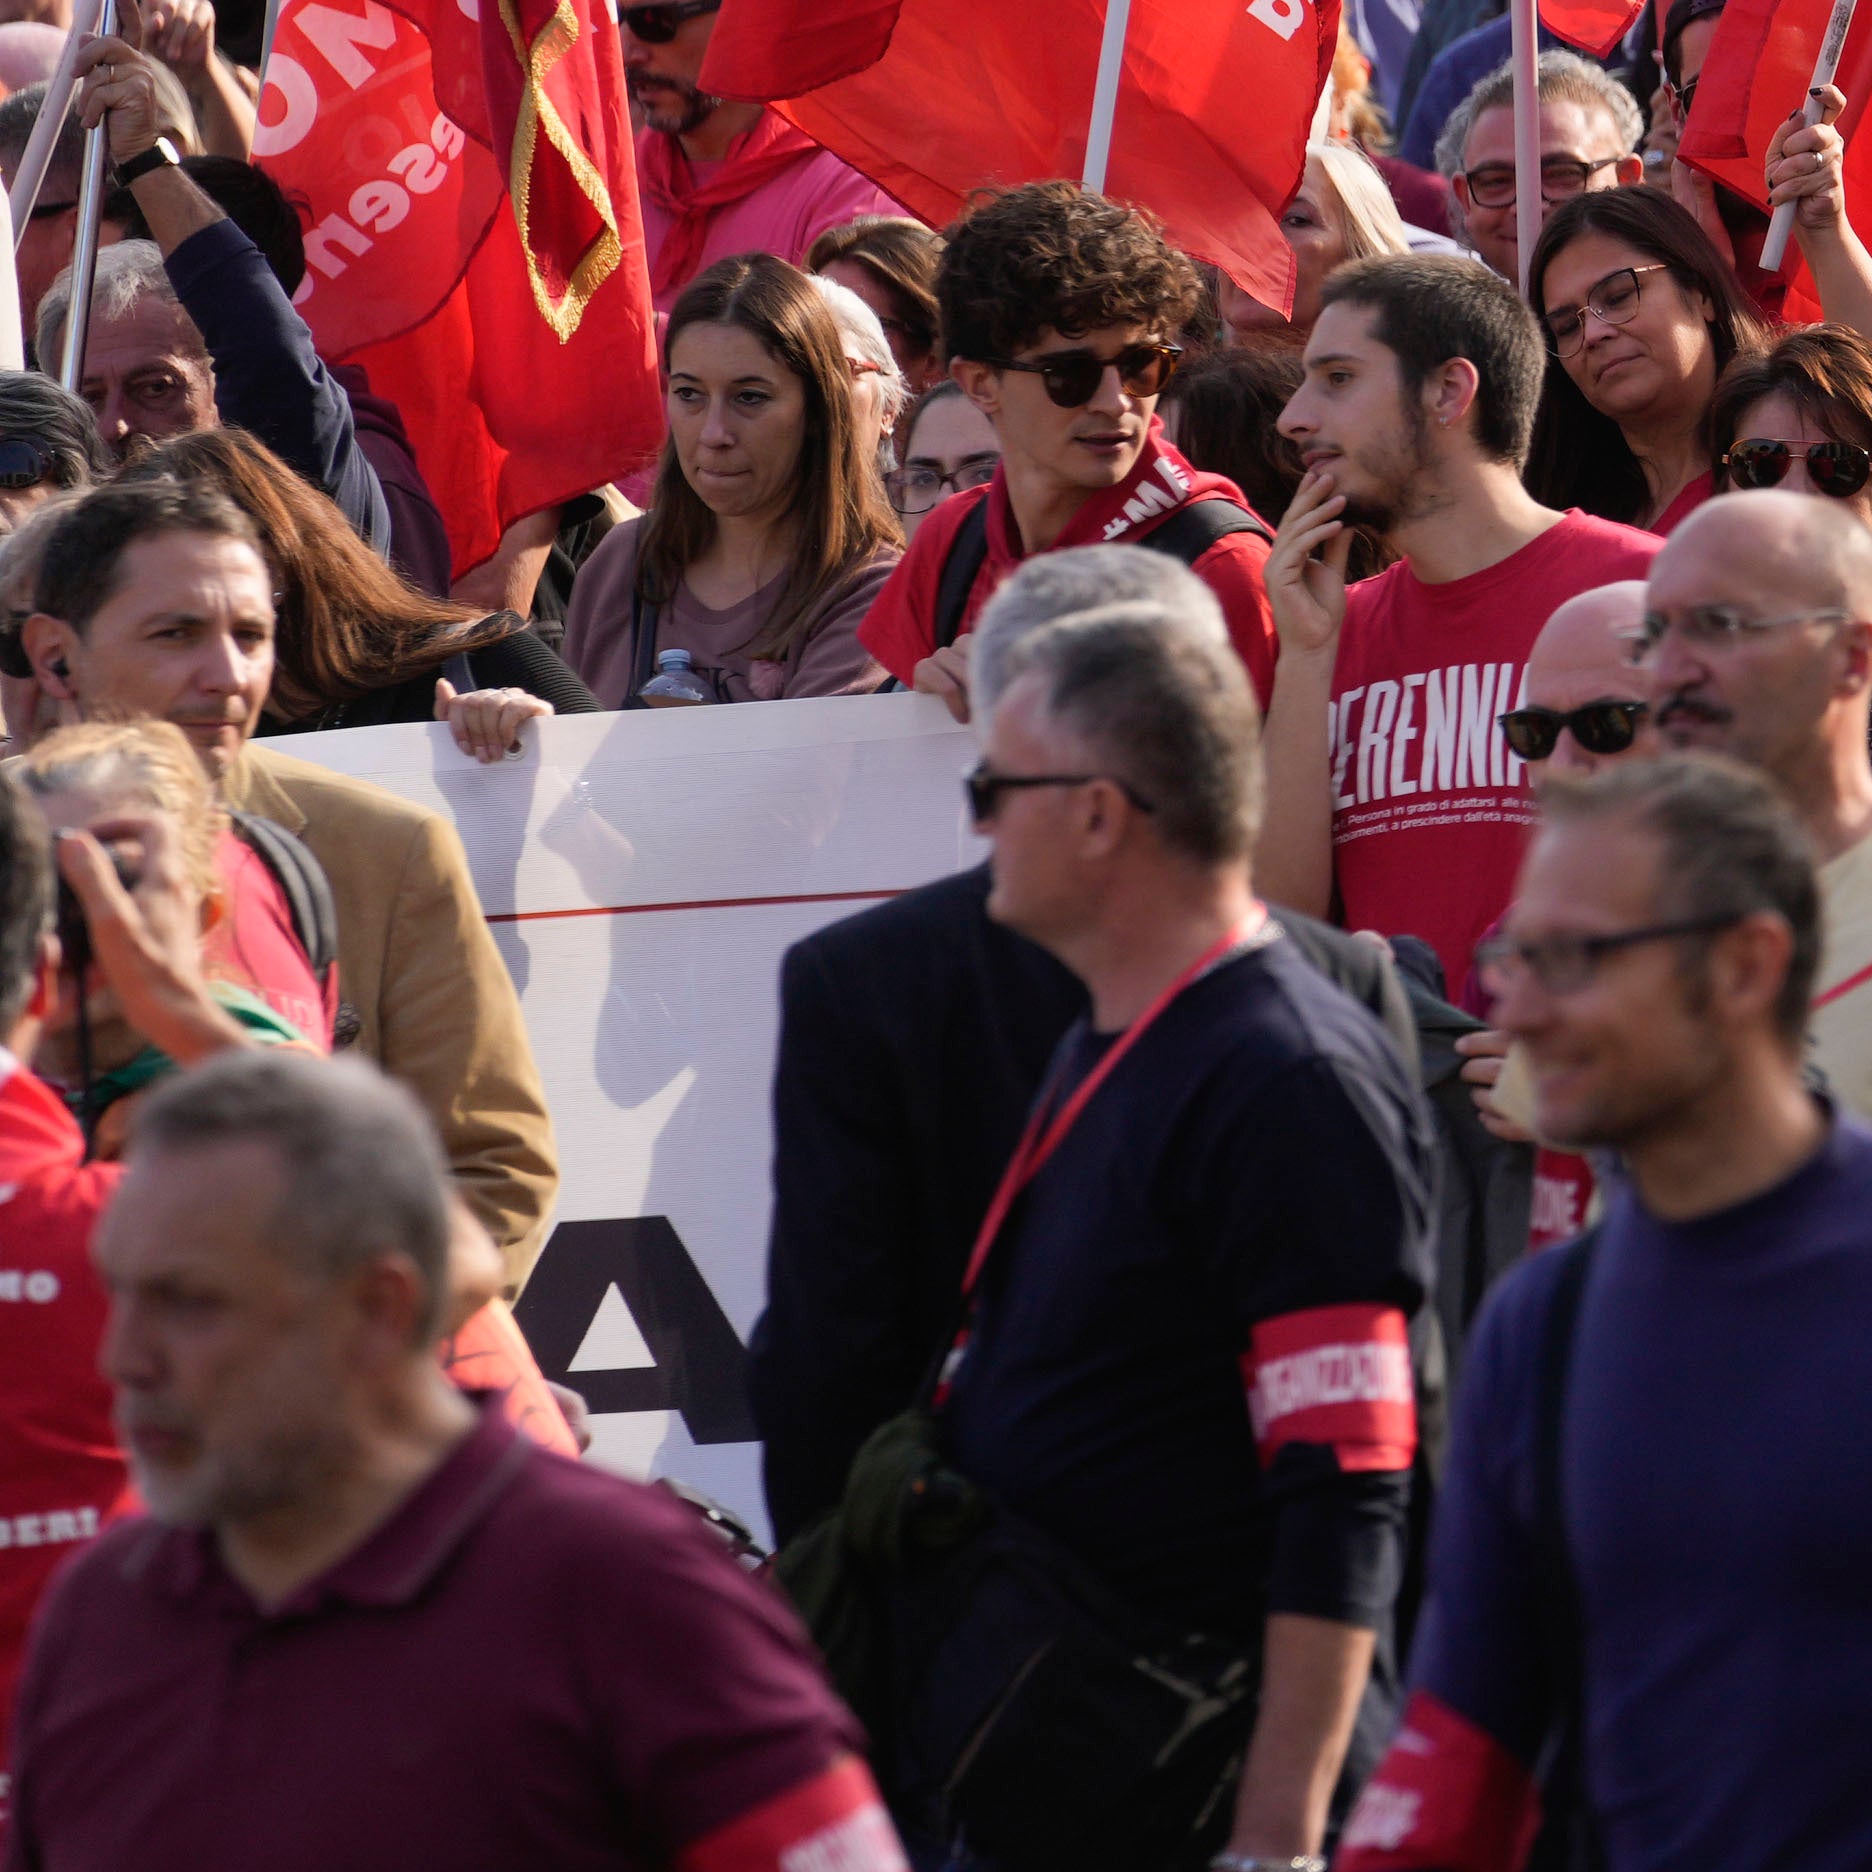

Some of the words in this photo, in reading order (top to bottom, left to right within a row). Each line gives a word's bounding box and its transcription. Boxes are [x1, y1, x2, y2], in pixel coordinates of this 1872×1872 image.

[1348, 809, 1392, 825] Persona
[1407, 801, 1438, 816] grado
[1452, 796, 1496, 809] adattarsi
[1502, 797, 1519, 809] alle
[1401, 813, 1461, 830] prescindere
